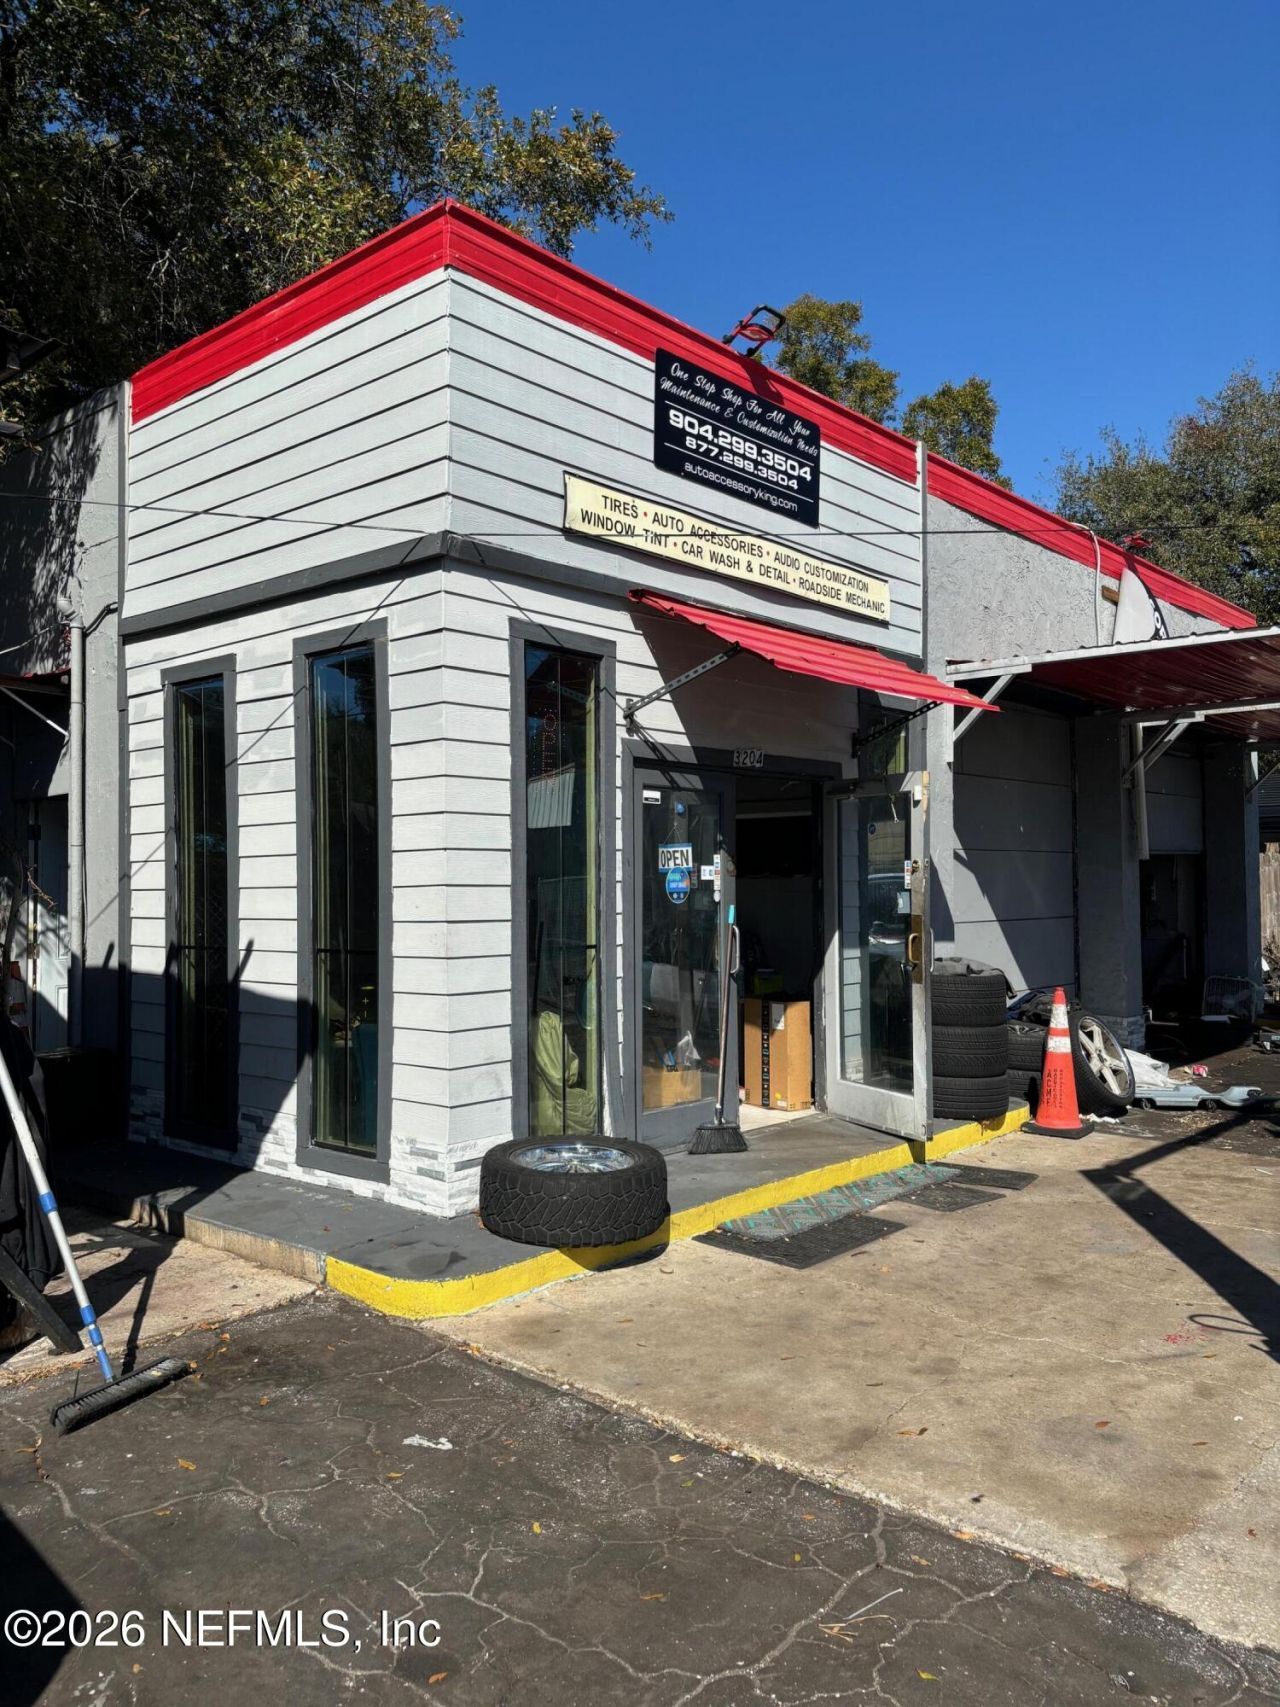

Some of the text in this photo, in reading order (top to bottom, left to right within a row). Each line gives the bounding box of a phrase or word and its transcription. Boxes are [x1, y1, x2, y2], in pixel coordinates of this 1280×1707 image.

[660, 376, 819, 457] Maintenance & Customization Needs
[671, 362, 810, 436] One Stop Shop For All Your
[669, 409, 812, 482] 904.299.3504
[685, 436, 799, 490] 877.299.3504
[684, 462, 798, 512] autoaccessoryking.com
[580, 508, 635, 539] WINDOW
[682, 541, 703, 560] CAR
[709, 551, 740, 571] WASH
[746, 561, 754, 573] &
[759, 564, 791, 584] DETAIL
[799, 577, 842, 601] ROADSIDE
[846, 592, 885, 614] MECHANIC
[602, 494, 869, 593] TIRES AUTO ACCESSORIES AUDIO CUSTOMIZATION
[735, 749, 763, 765] 3204
[660, 849, 689, 868] OPEN
